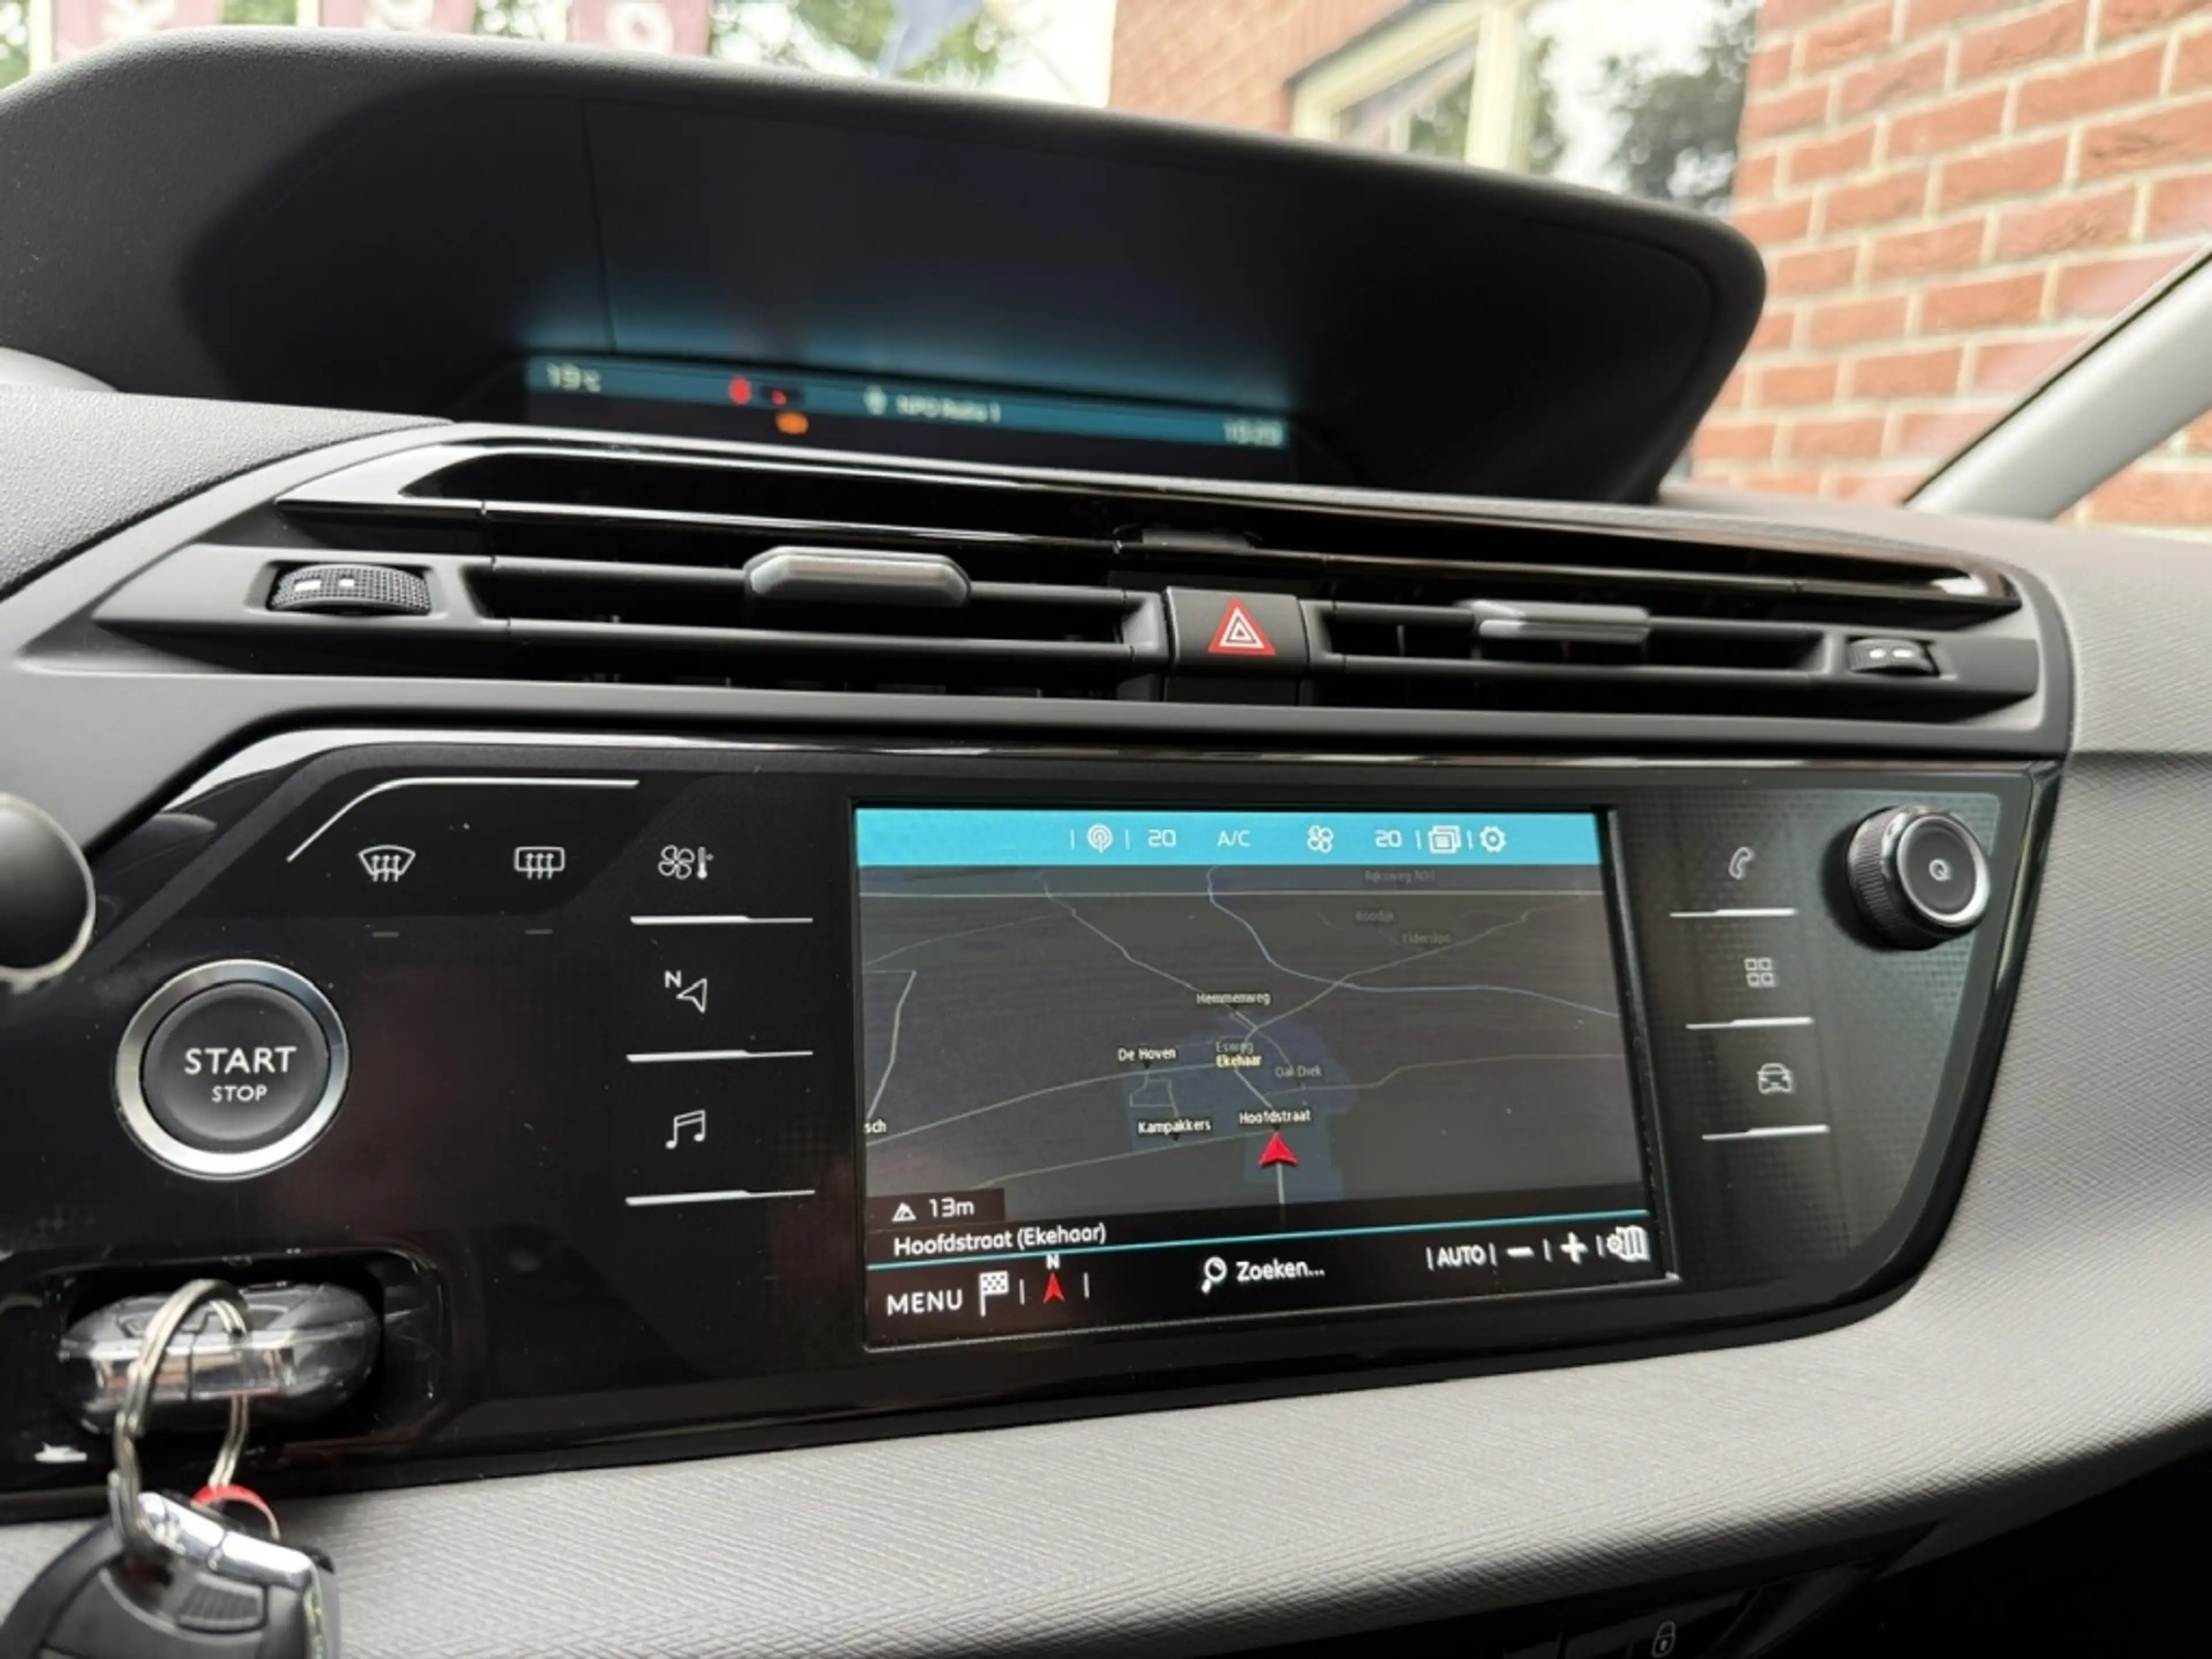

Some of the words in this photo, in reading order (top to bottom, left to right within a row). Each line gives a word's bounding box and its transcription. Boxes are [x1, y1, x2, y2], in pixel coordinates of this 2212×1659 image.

[1147, 829, 1177, 848] 20
[1217, 830, 1252, 848] A/C
[1375, 829, 1403, 849] 20
[184, 1046, 298, 1075] START
[1118, 1047, 1135, 1062] De
[1215, 1054, 1263, 1069] Ekehaar
[211, 1085, 268, 1103] STOP
[1138, 1118, 1211, 1135] Kampakkers
[1238, 1109, 1312, 1124] Hoofdstraat
[929, 1197, 975, 1218] 13m
[894, 1229, 1013, 1256] Hoofdstraat
[1017, 1222, 1107, 1251] (Ekehaar)
[1437, 1244, 1487, 1267] AUTO
[1236, 1258, 1325, 1283] Zoeken...
[887, 1289, 963, 1316] MENU
